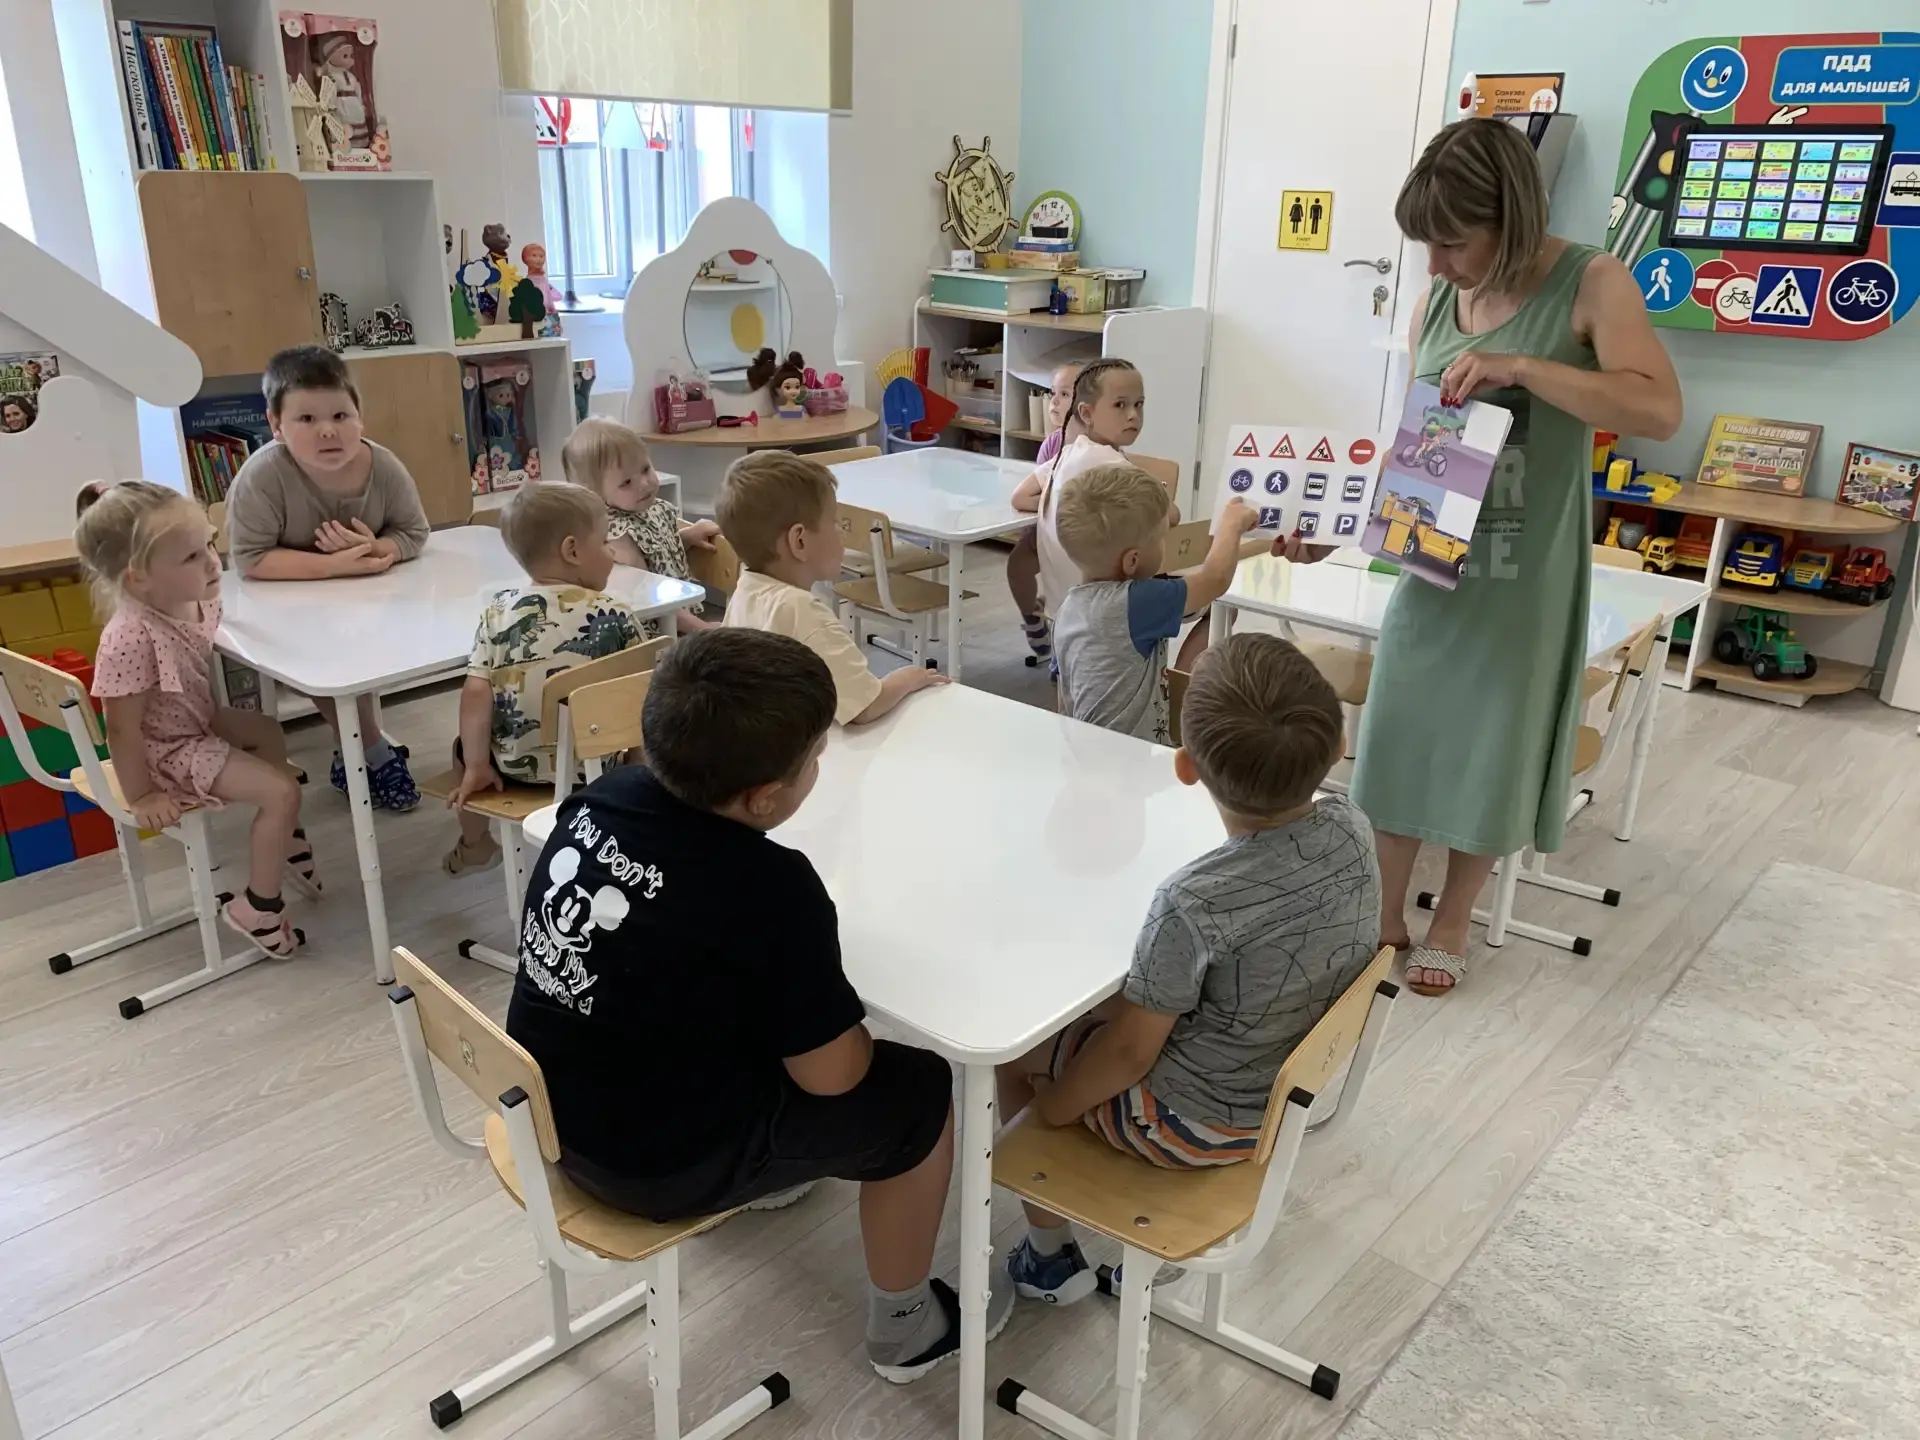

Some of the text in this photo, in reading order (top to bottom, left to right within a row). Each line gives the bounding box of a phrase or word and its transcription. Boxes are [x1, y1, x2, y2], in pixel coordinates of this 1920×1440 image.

[159, 42, 170, 71] АГНИЯ
[167, 73, 178, 100] БАРТО
[1823, 54, 1872, 73] ПДД
[125, 45, 147, 118] Насекомые
[1780, 77, 1910, 96] ДЛЯ МАЛЫШЕЙ
[1338, 516, 1353, 533] P
